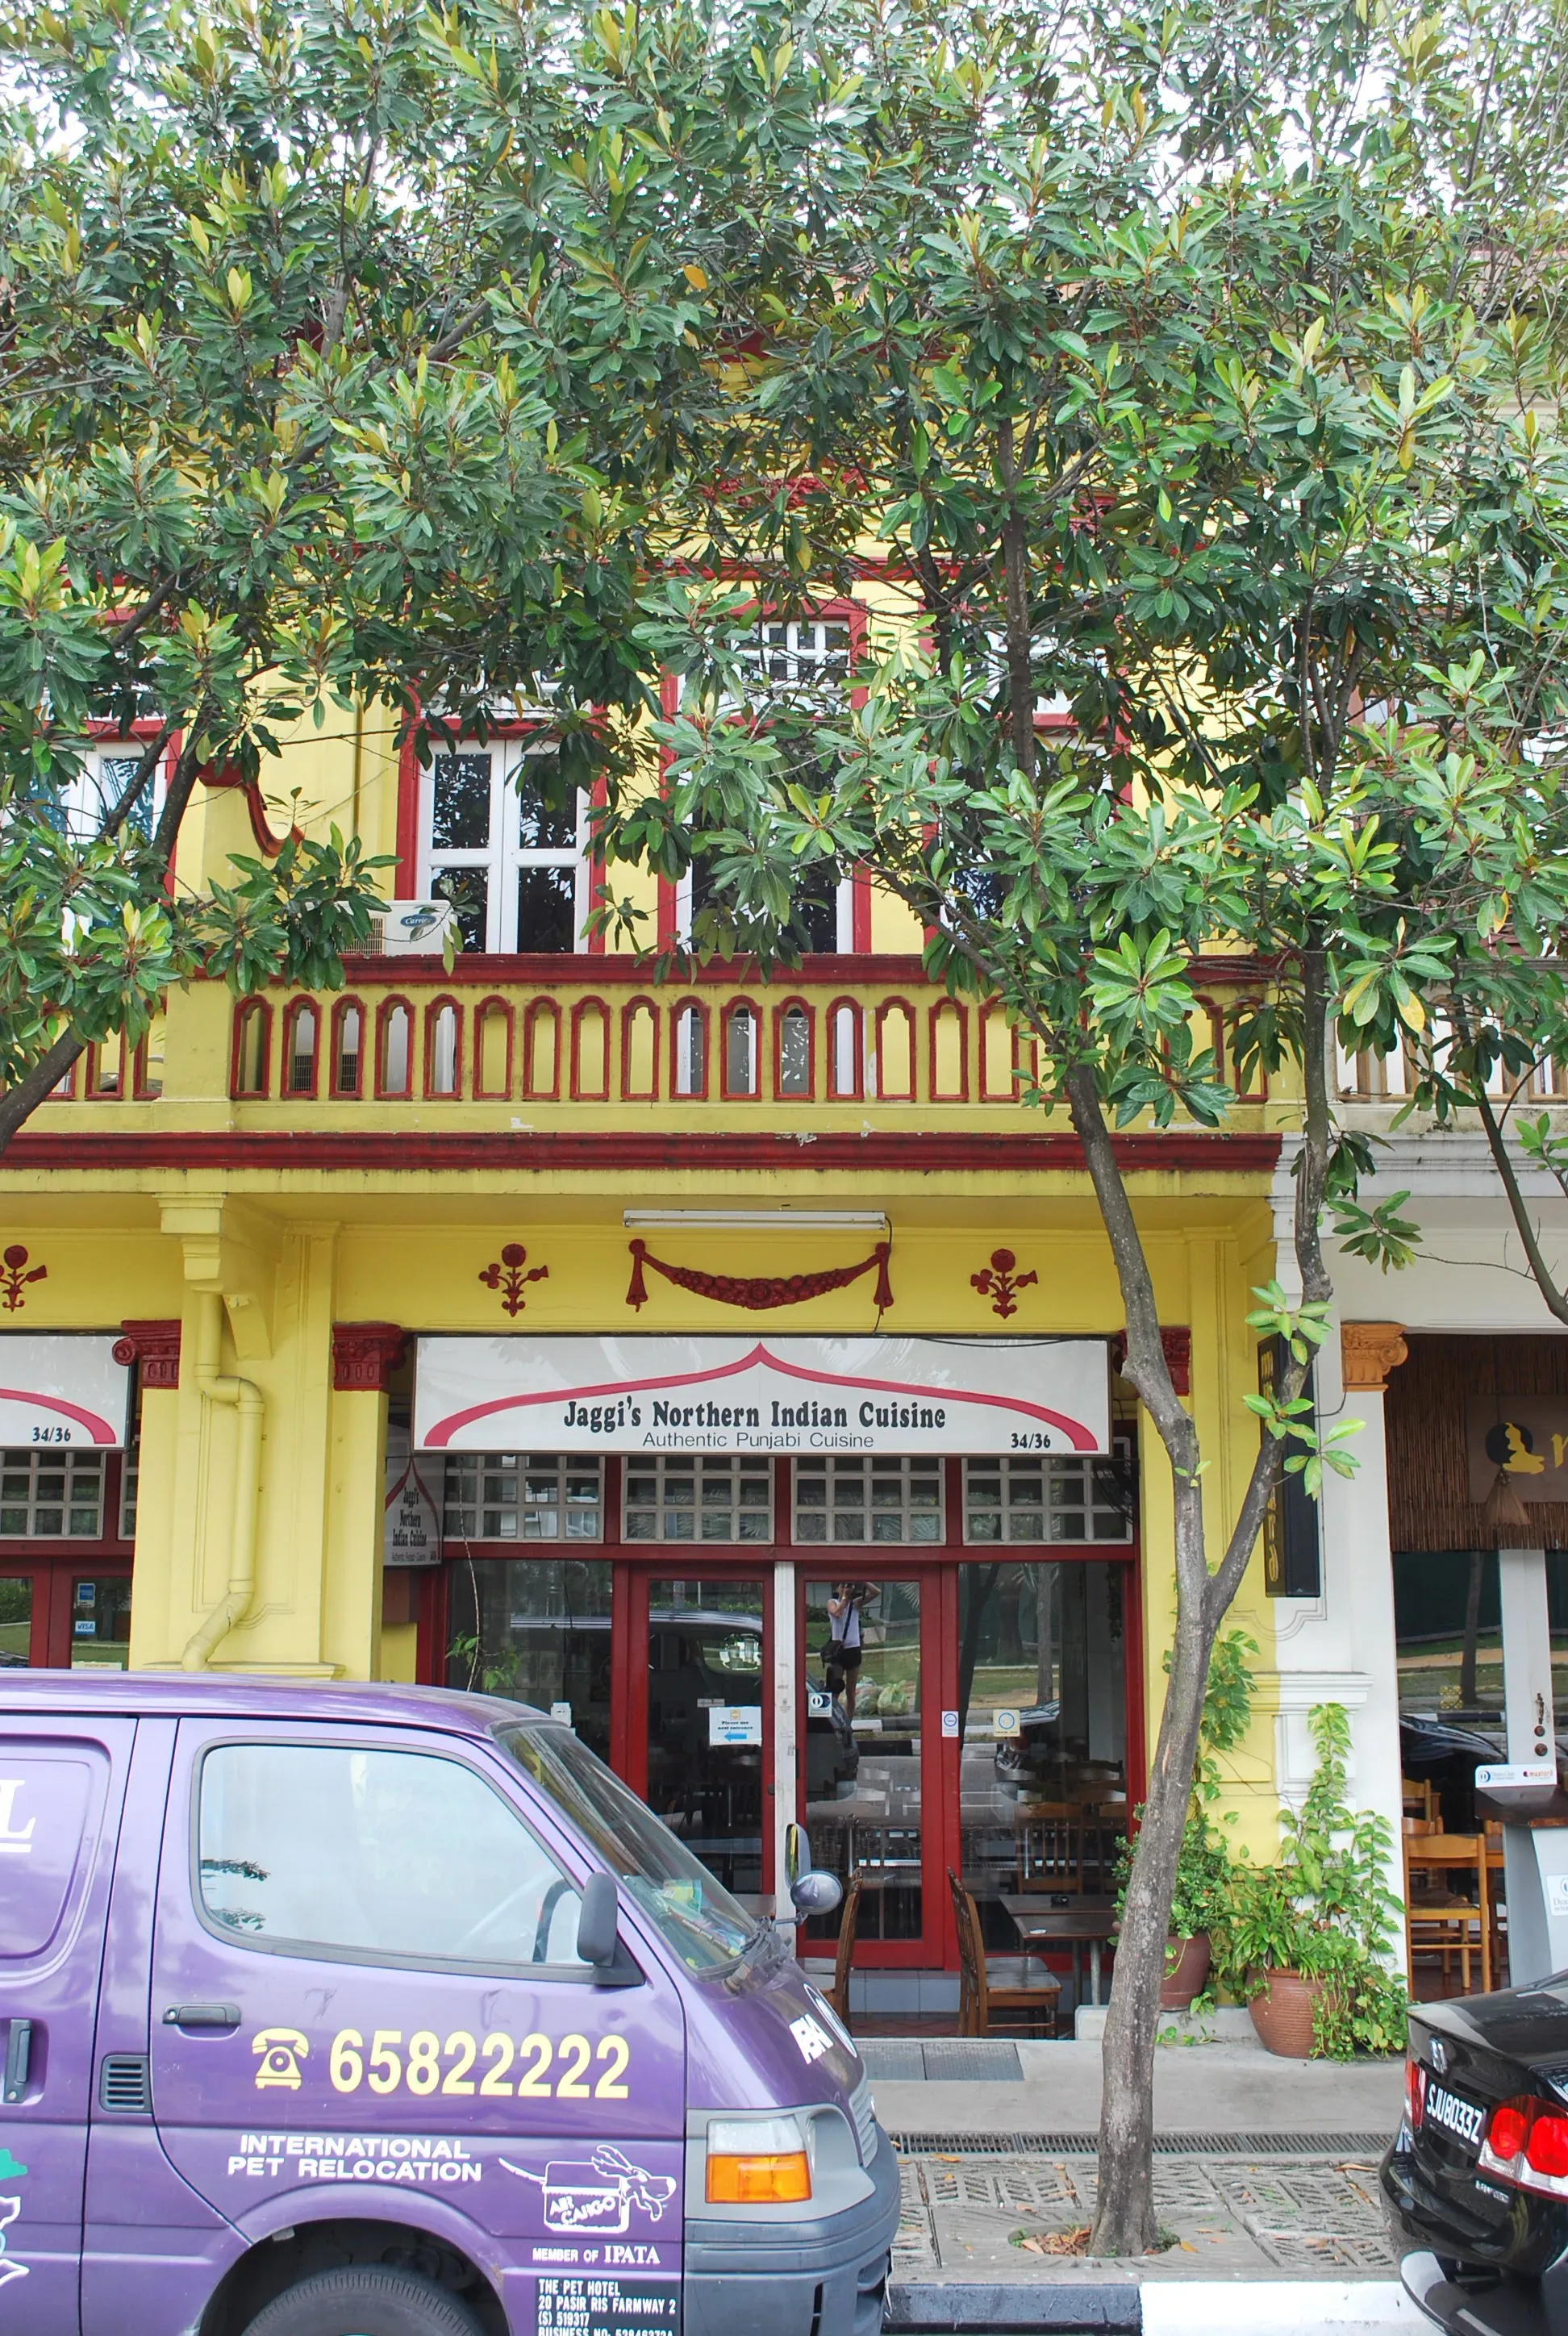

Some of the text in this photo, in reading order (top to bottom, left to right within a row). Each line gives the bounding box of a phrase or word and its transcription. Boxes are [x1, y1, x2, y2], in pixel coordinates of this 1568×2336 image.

[565, 1395, 945, 1433] Jaggi's Northern Indian Cuisine
[32, 1426, 71, 1442] 34/36
[642, 1433, 874, 1450] Authentic Punjabi Cuisine
[1011, 1433, 1051, 1449] 34/36
[329, 2029, 630, 2099] 65822222
[1427, 2083, 1483, 2146] SJU8033Z
[240, 2134, 470, 2159] INTERNATIONAL
[227, 2156, 482, 2181] PET RELOCATION
[532, 2245, 661, 2264] MEMBER OF IPATA
[538, 2279, 620, 2296] THE PET HOTEL
[538, 2295, 676, 2314] 20 PASIR RIS FARMWAY 2
[538, 2311, 590, 2328] (S) 519317
